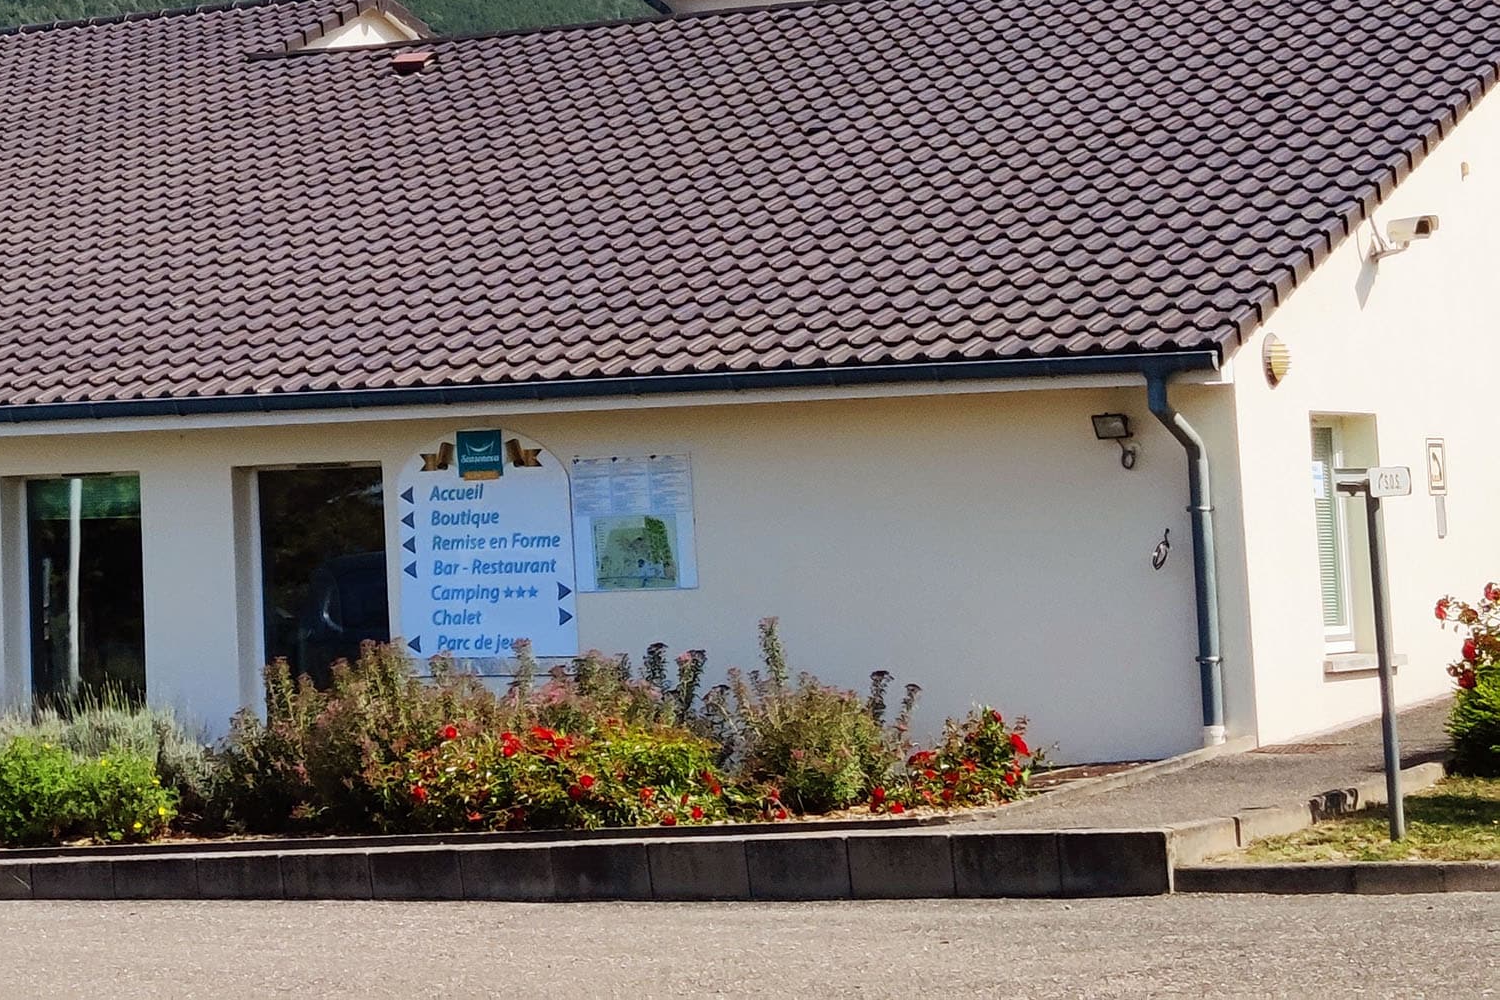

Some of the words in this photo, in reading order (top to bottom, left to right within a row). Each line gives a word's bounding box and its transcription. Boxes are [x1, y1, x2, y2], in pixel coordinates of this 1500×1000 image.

[430, 483, 484, 501] Accueil
[431, 509, 500, 528] Boutique
[432, 534, 486, 551] Remise
[489, 538, 507, 549] en
[512, 532, 561, 549] Forme
[433, 560, 460, 576] Bar
[472, 558, 557, 575] Restaurant
[431, 584, 500, 604] Camping
[432, 608, 482, 626] Chalet
[438, 635, 470, 650] Parc
[474, 634, 492, 650] de
